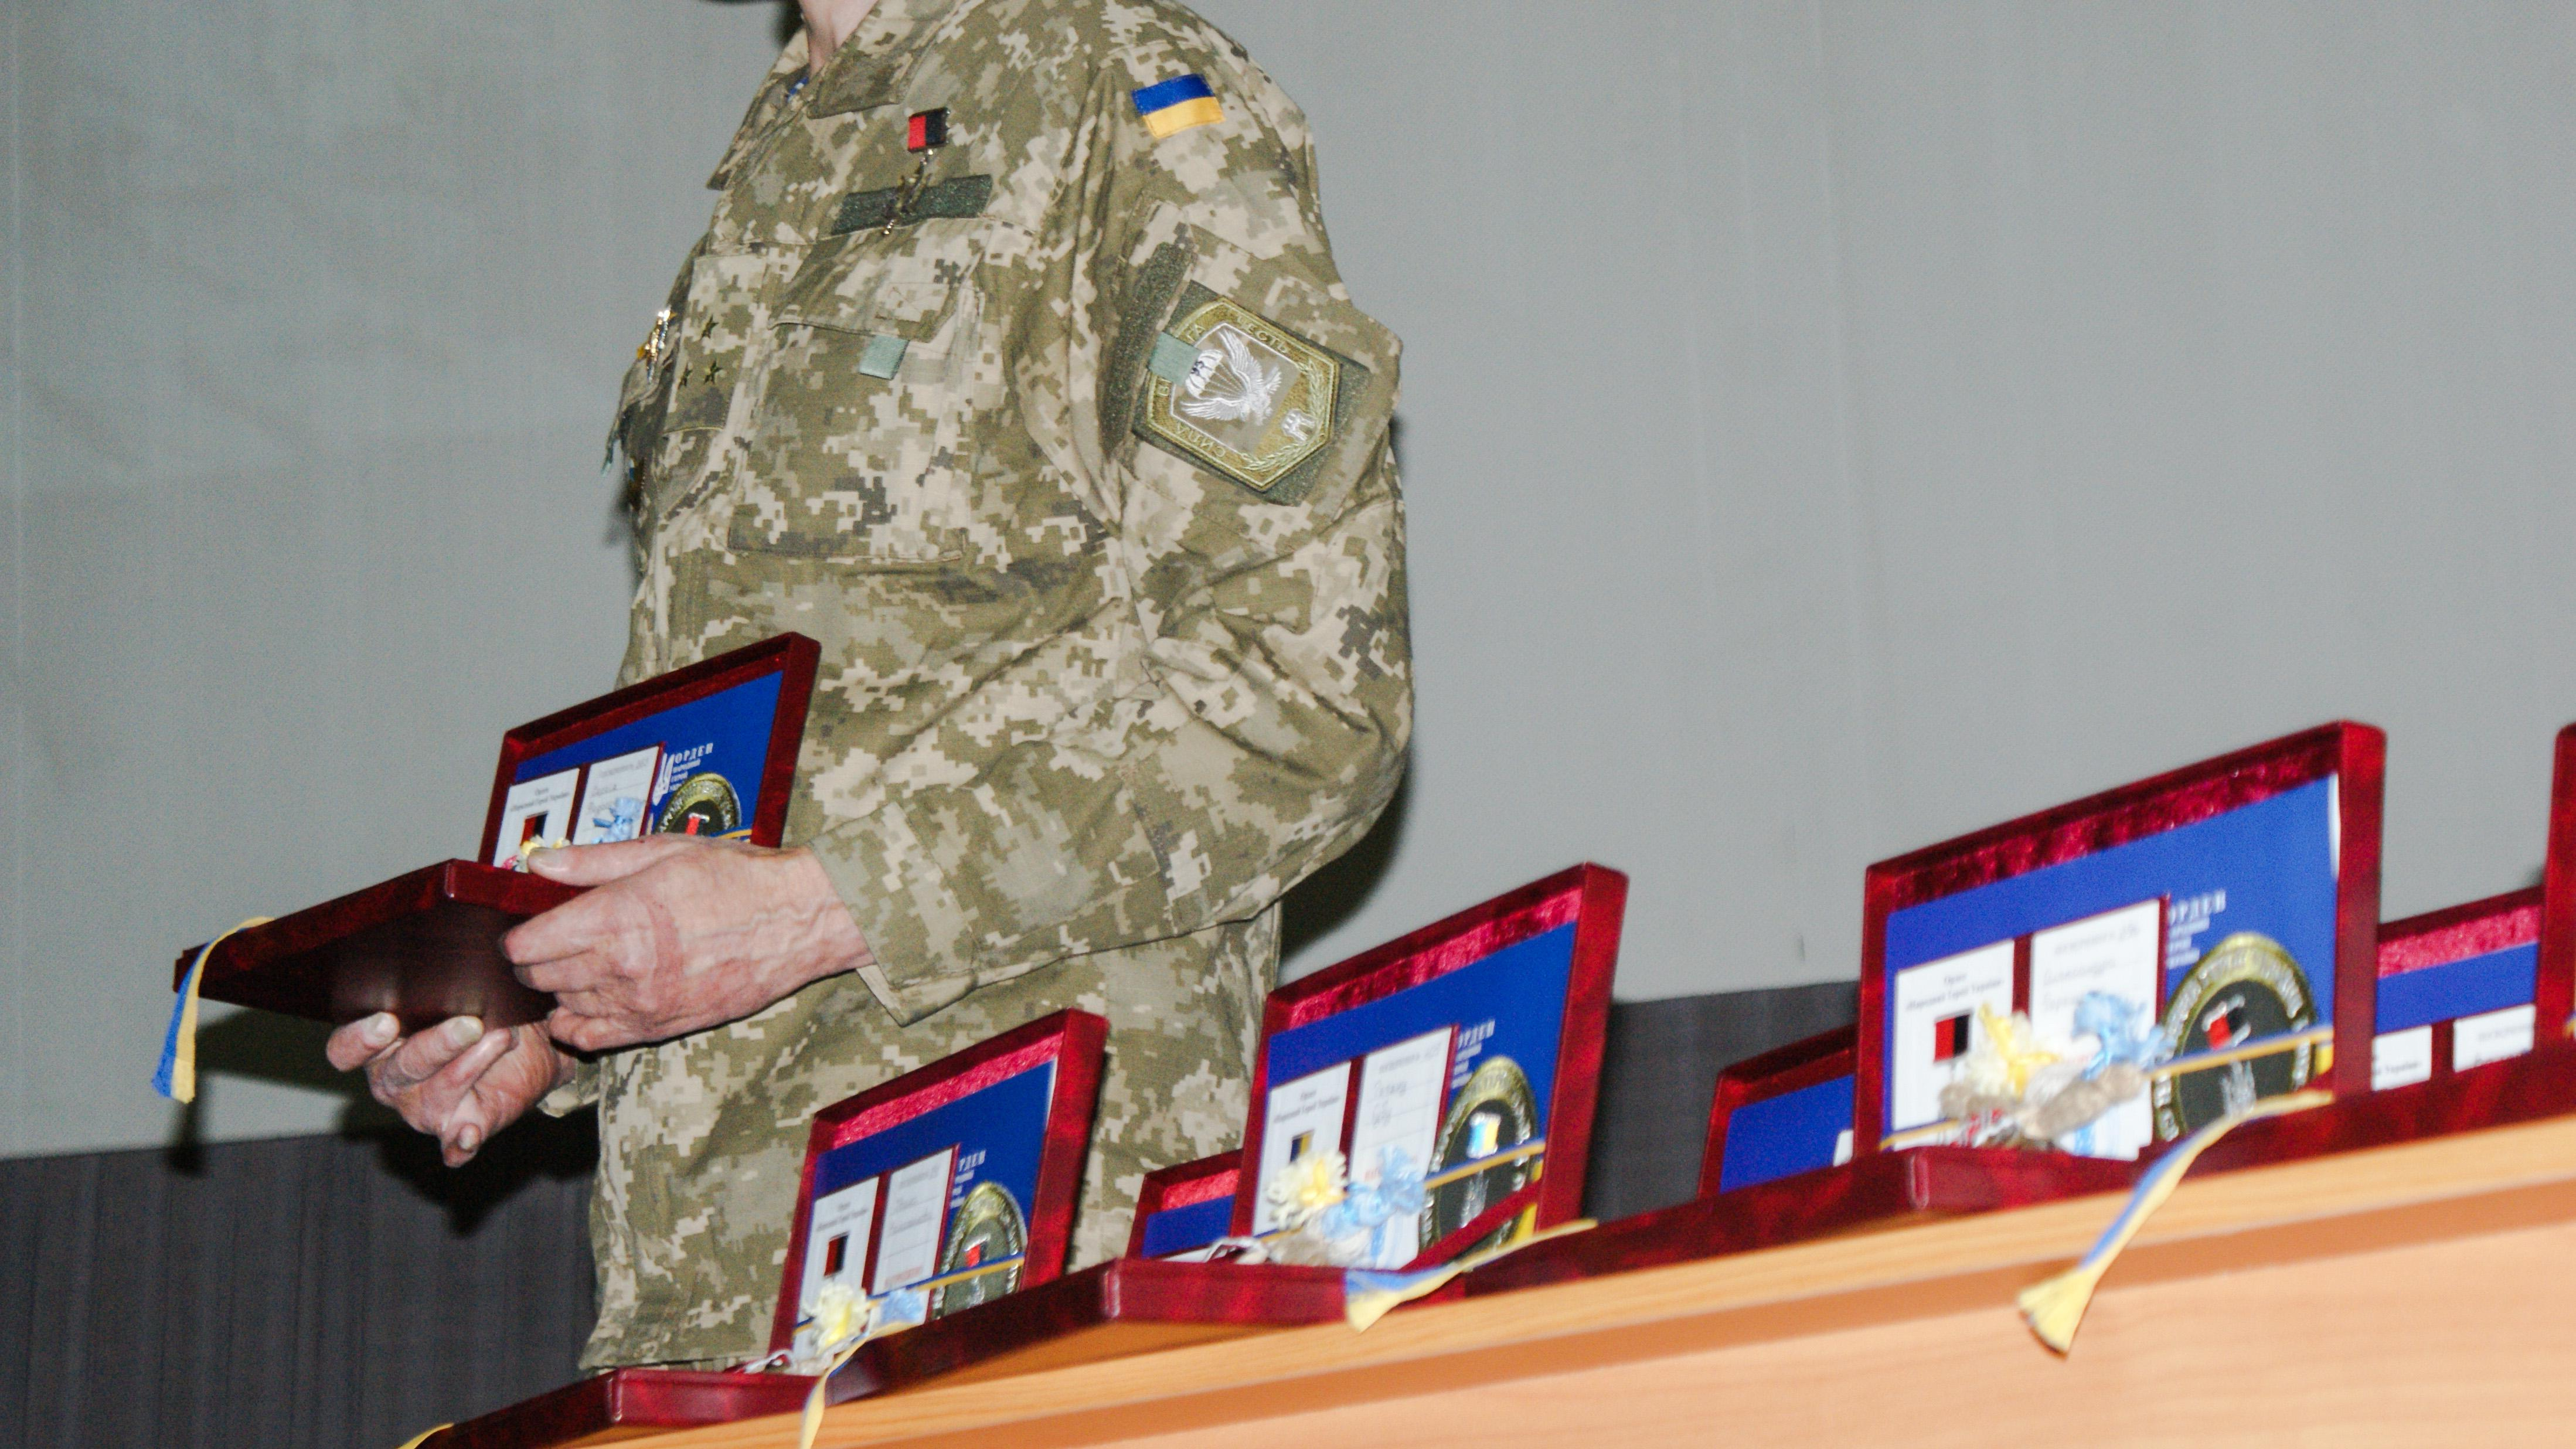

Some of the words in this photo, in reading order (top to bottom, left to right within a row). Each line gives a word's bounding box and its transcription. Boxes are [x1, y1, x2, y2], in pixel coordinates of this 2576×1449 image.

[1237, 315, 1289, 353] ЧЕСТЬ
[1156, 323, 1206, 397] ВІГА
[1176, 421, 1226, 458] СИЛА
[675, 742, 714, 764] ОРДЕН
